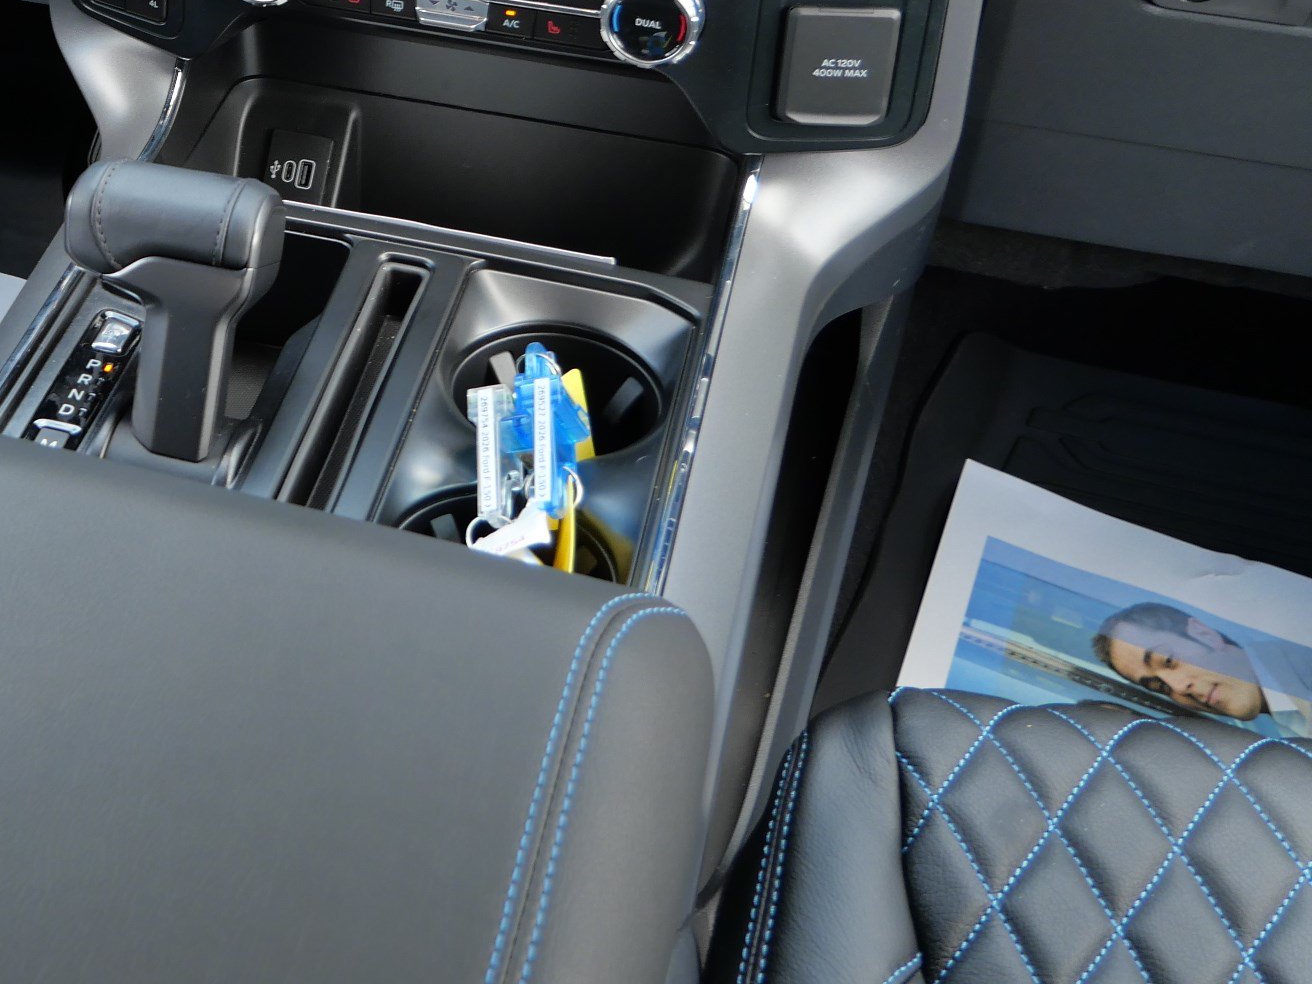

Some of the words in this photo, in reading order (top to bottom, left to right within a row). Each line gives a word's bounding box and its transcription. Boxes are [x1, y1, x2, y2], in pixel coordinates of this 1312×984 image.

[149, 0, 159, 9] 4L
[503, 18, 520, 29] A/C
[634, 17, 662, 30] DUAL
[821, 58, 836, 67] AC
[837, 59, 862, 68] 120V
[812, 68, 843, 77] 400W
[844, 69, 868, 78] MAX
[86, 359, 102, 369] P
[77, 373, 93, 385] R
[67, 388, 85, 400] N
[58, 403, 75, 415] D
